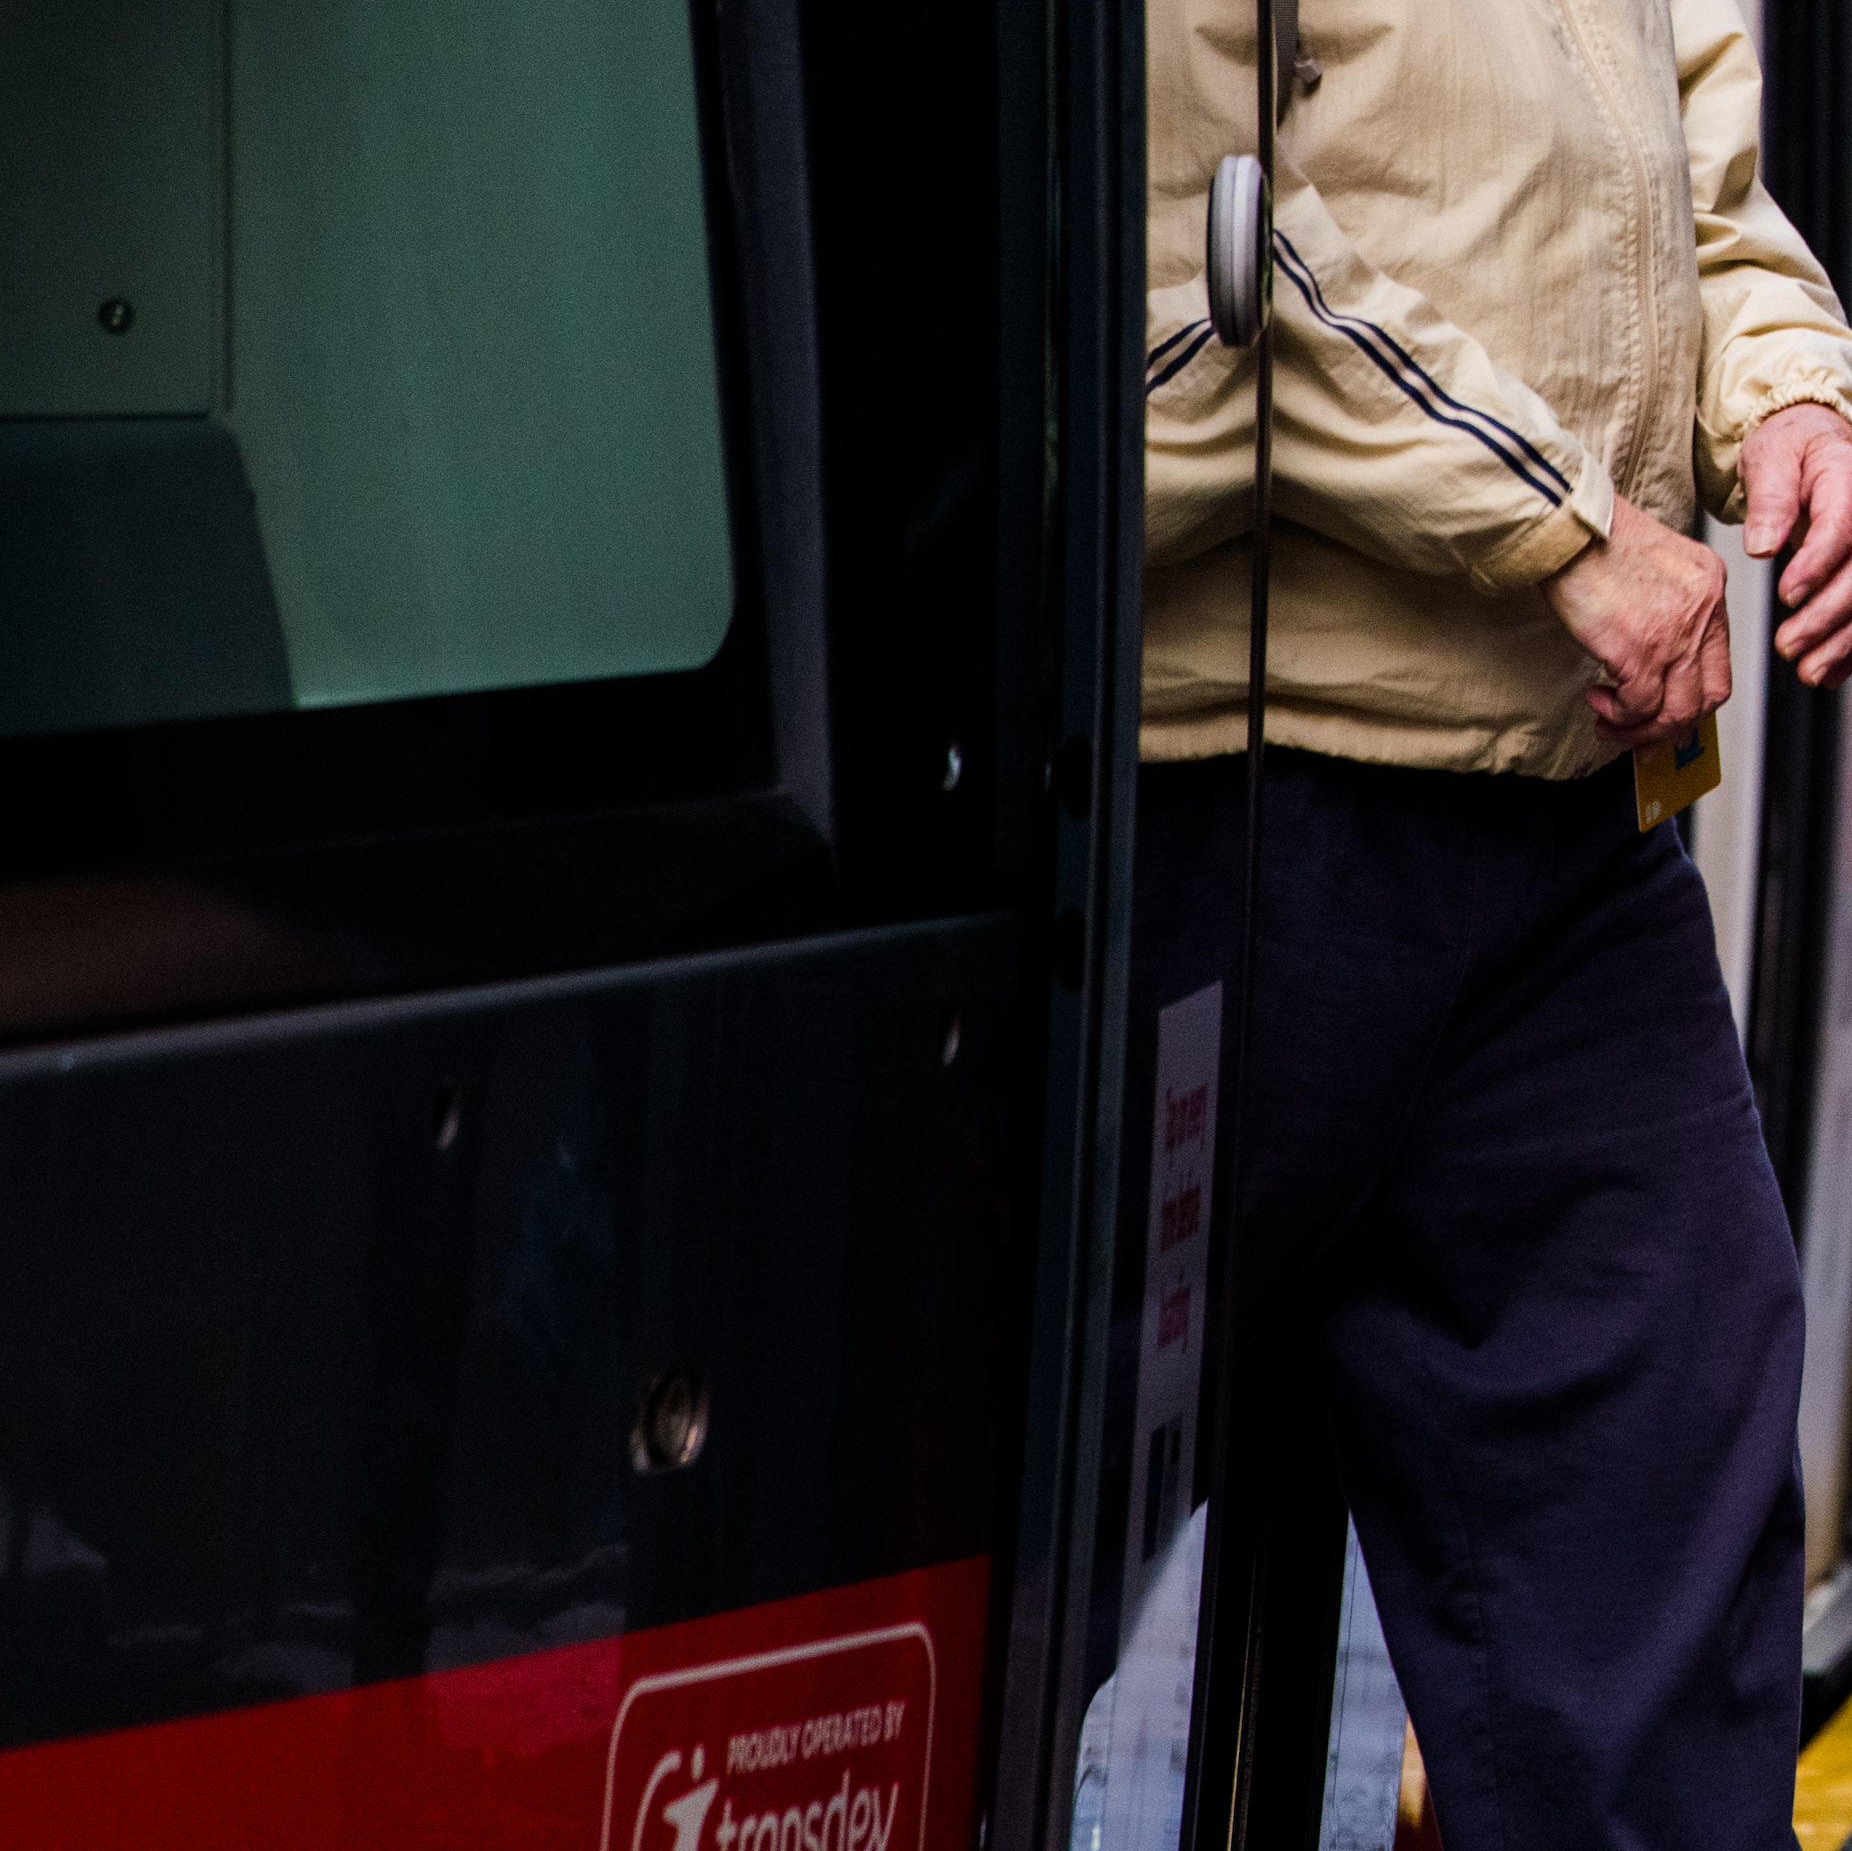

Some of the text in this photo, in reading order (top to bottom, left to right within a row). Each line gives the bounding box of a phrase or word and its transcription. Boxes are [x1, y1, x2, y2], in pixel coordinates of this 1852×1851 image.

[726, 1700, 906, 1777] PROUDLY OPERATED BY
